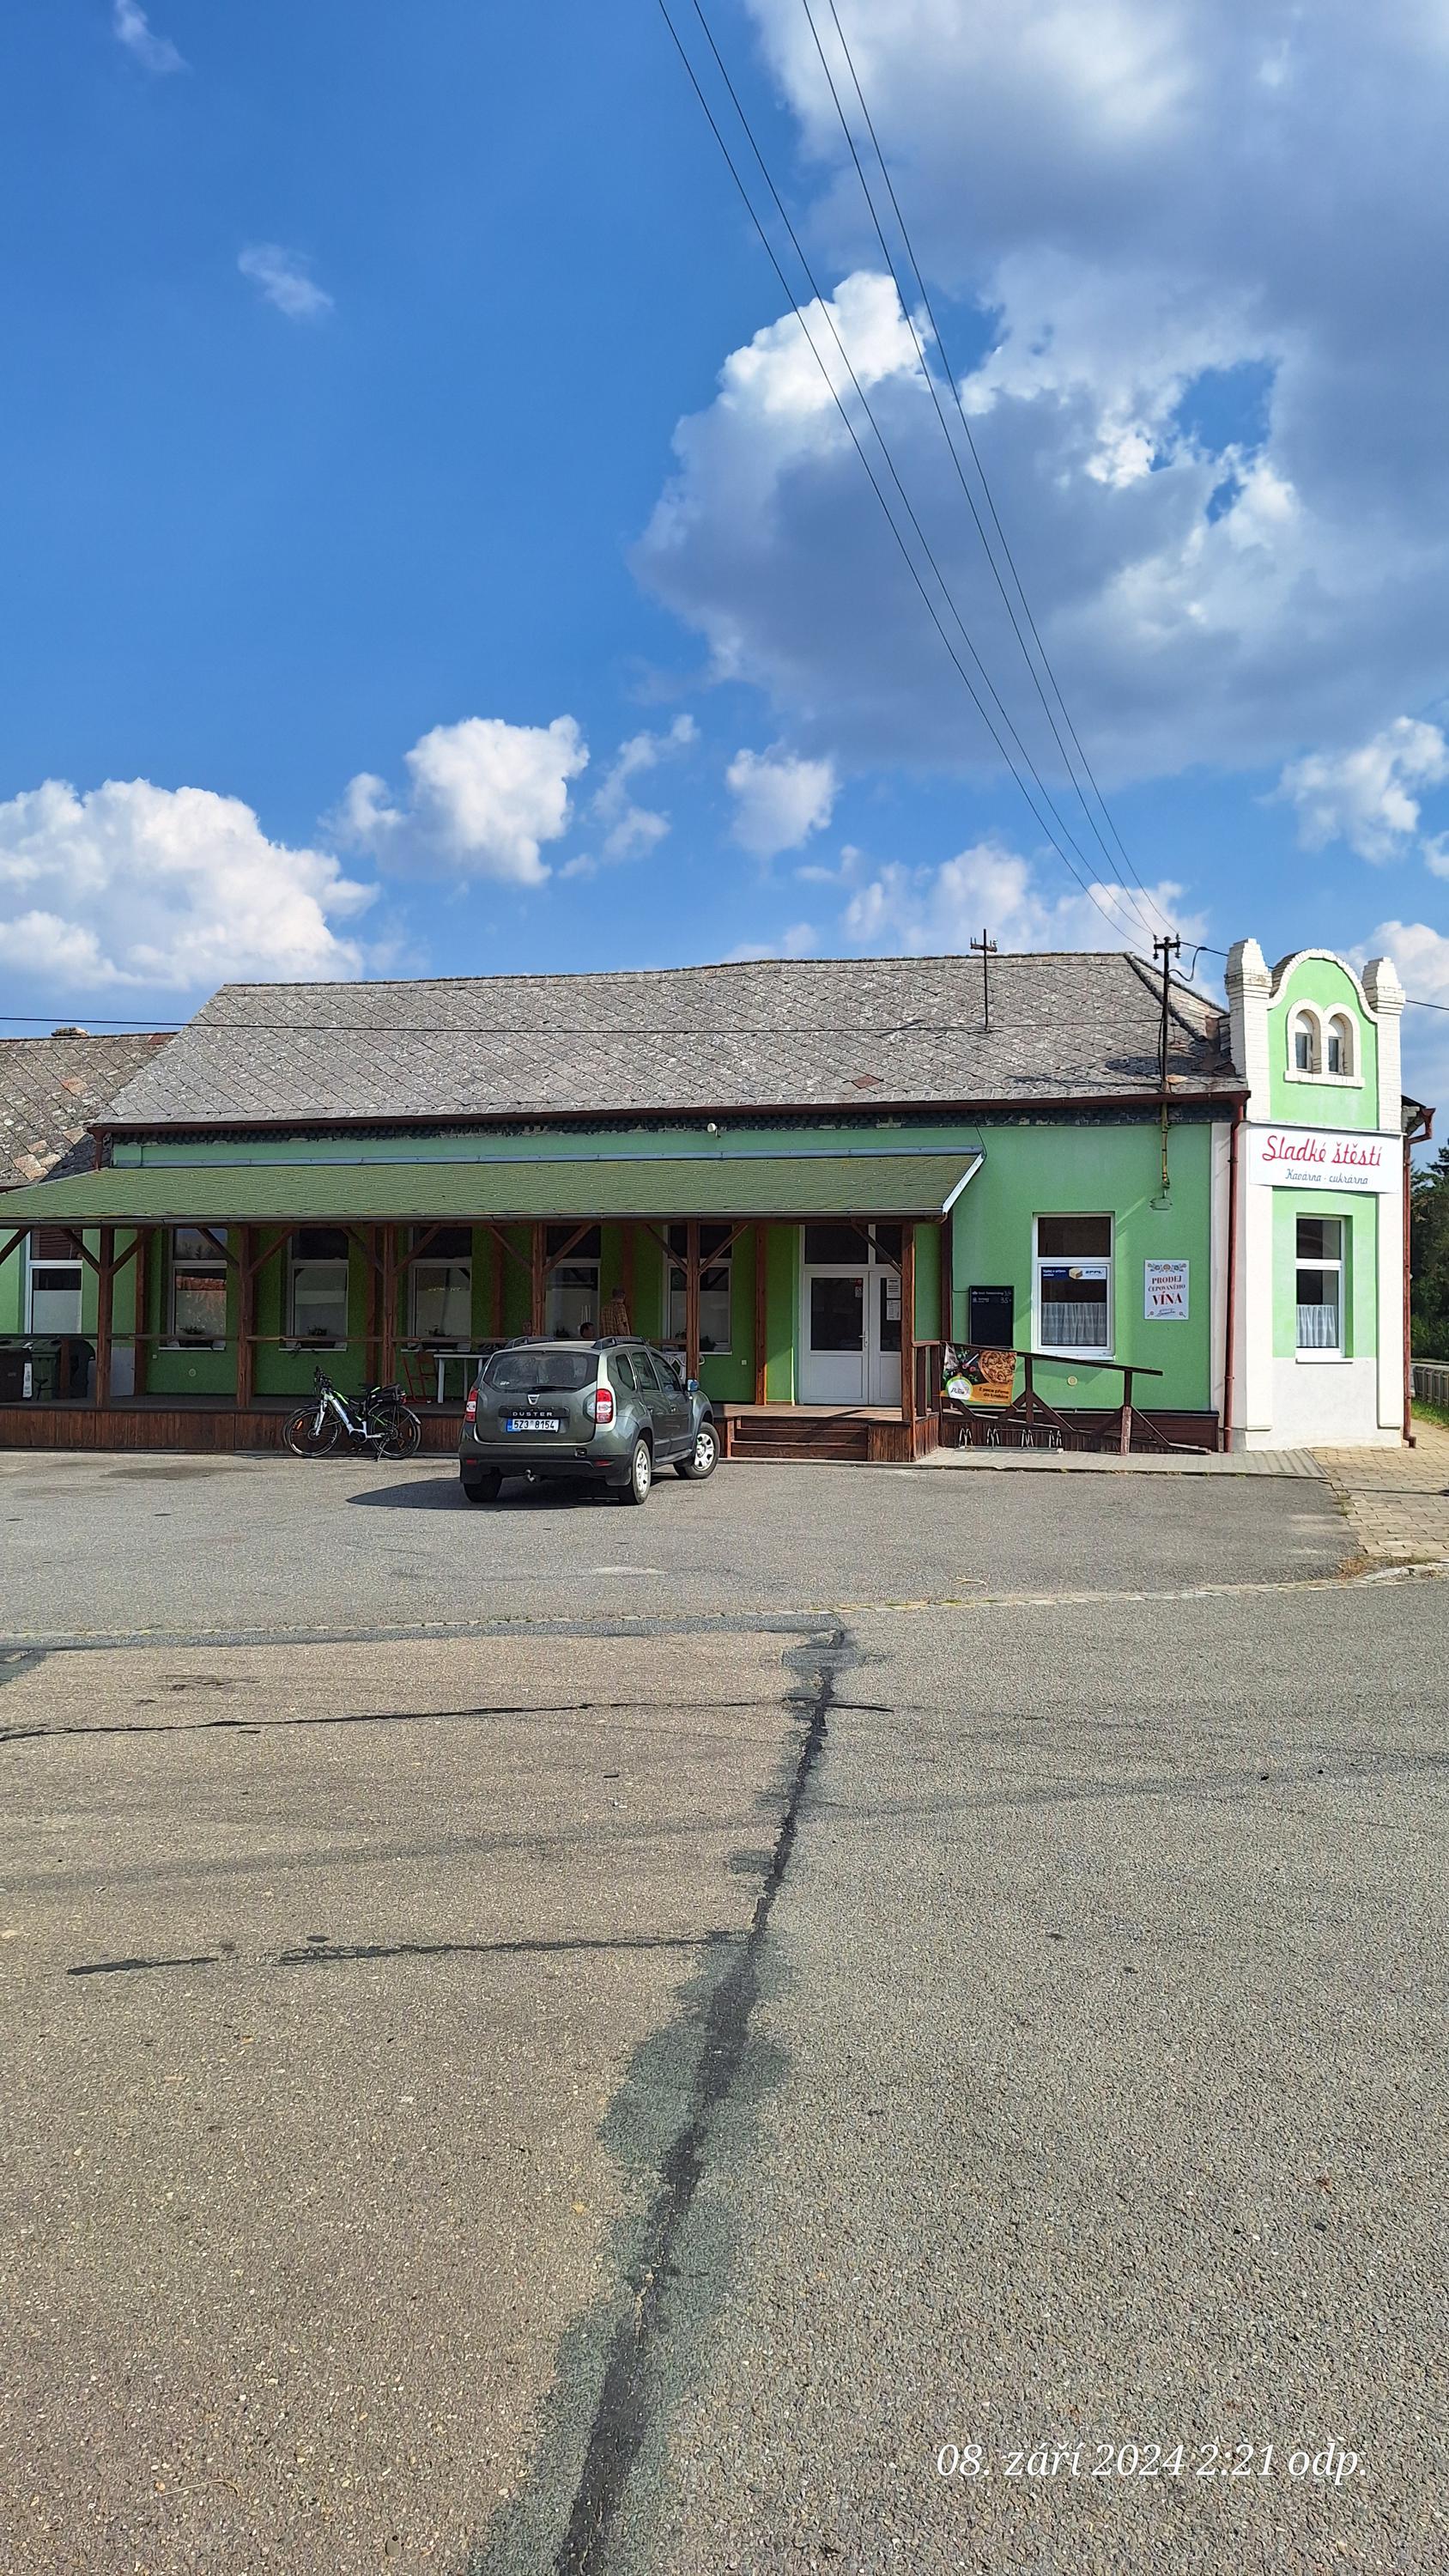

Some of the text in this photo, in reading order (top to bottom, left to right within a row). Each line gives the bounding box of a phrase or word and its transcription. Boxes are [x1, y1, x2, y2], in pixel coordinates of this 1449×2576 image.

[1262, 1135, 1383, 1166] Sladké štěstí
[1285, 1168, 1322, 1182] Kavárna
[1329, 1172, 1369, 1185] cukrárna
[1151, 1275, 1182, 1285] PRODEJ
[1152, 1291, 1183, 1305] VÍNA
[514, 1419, 555, 1429] 5Z3 8154
